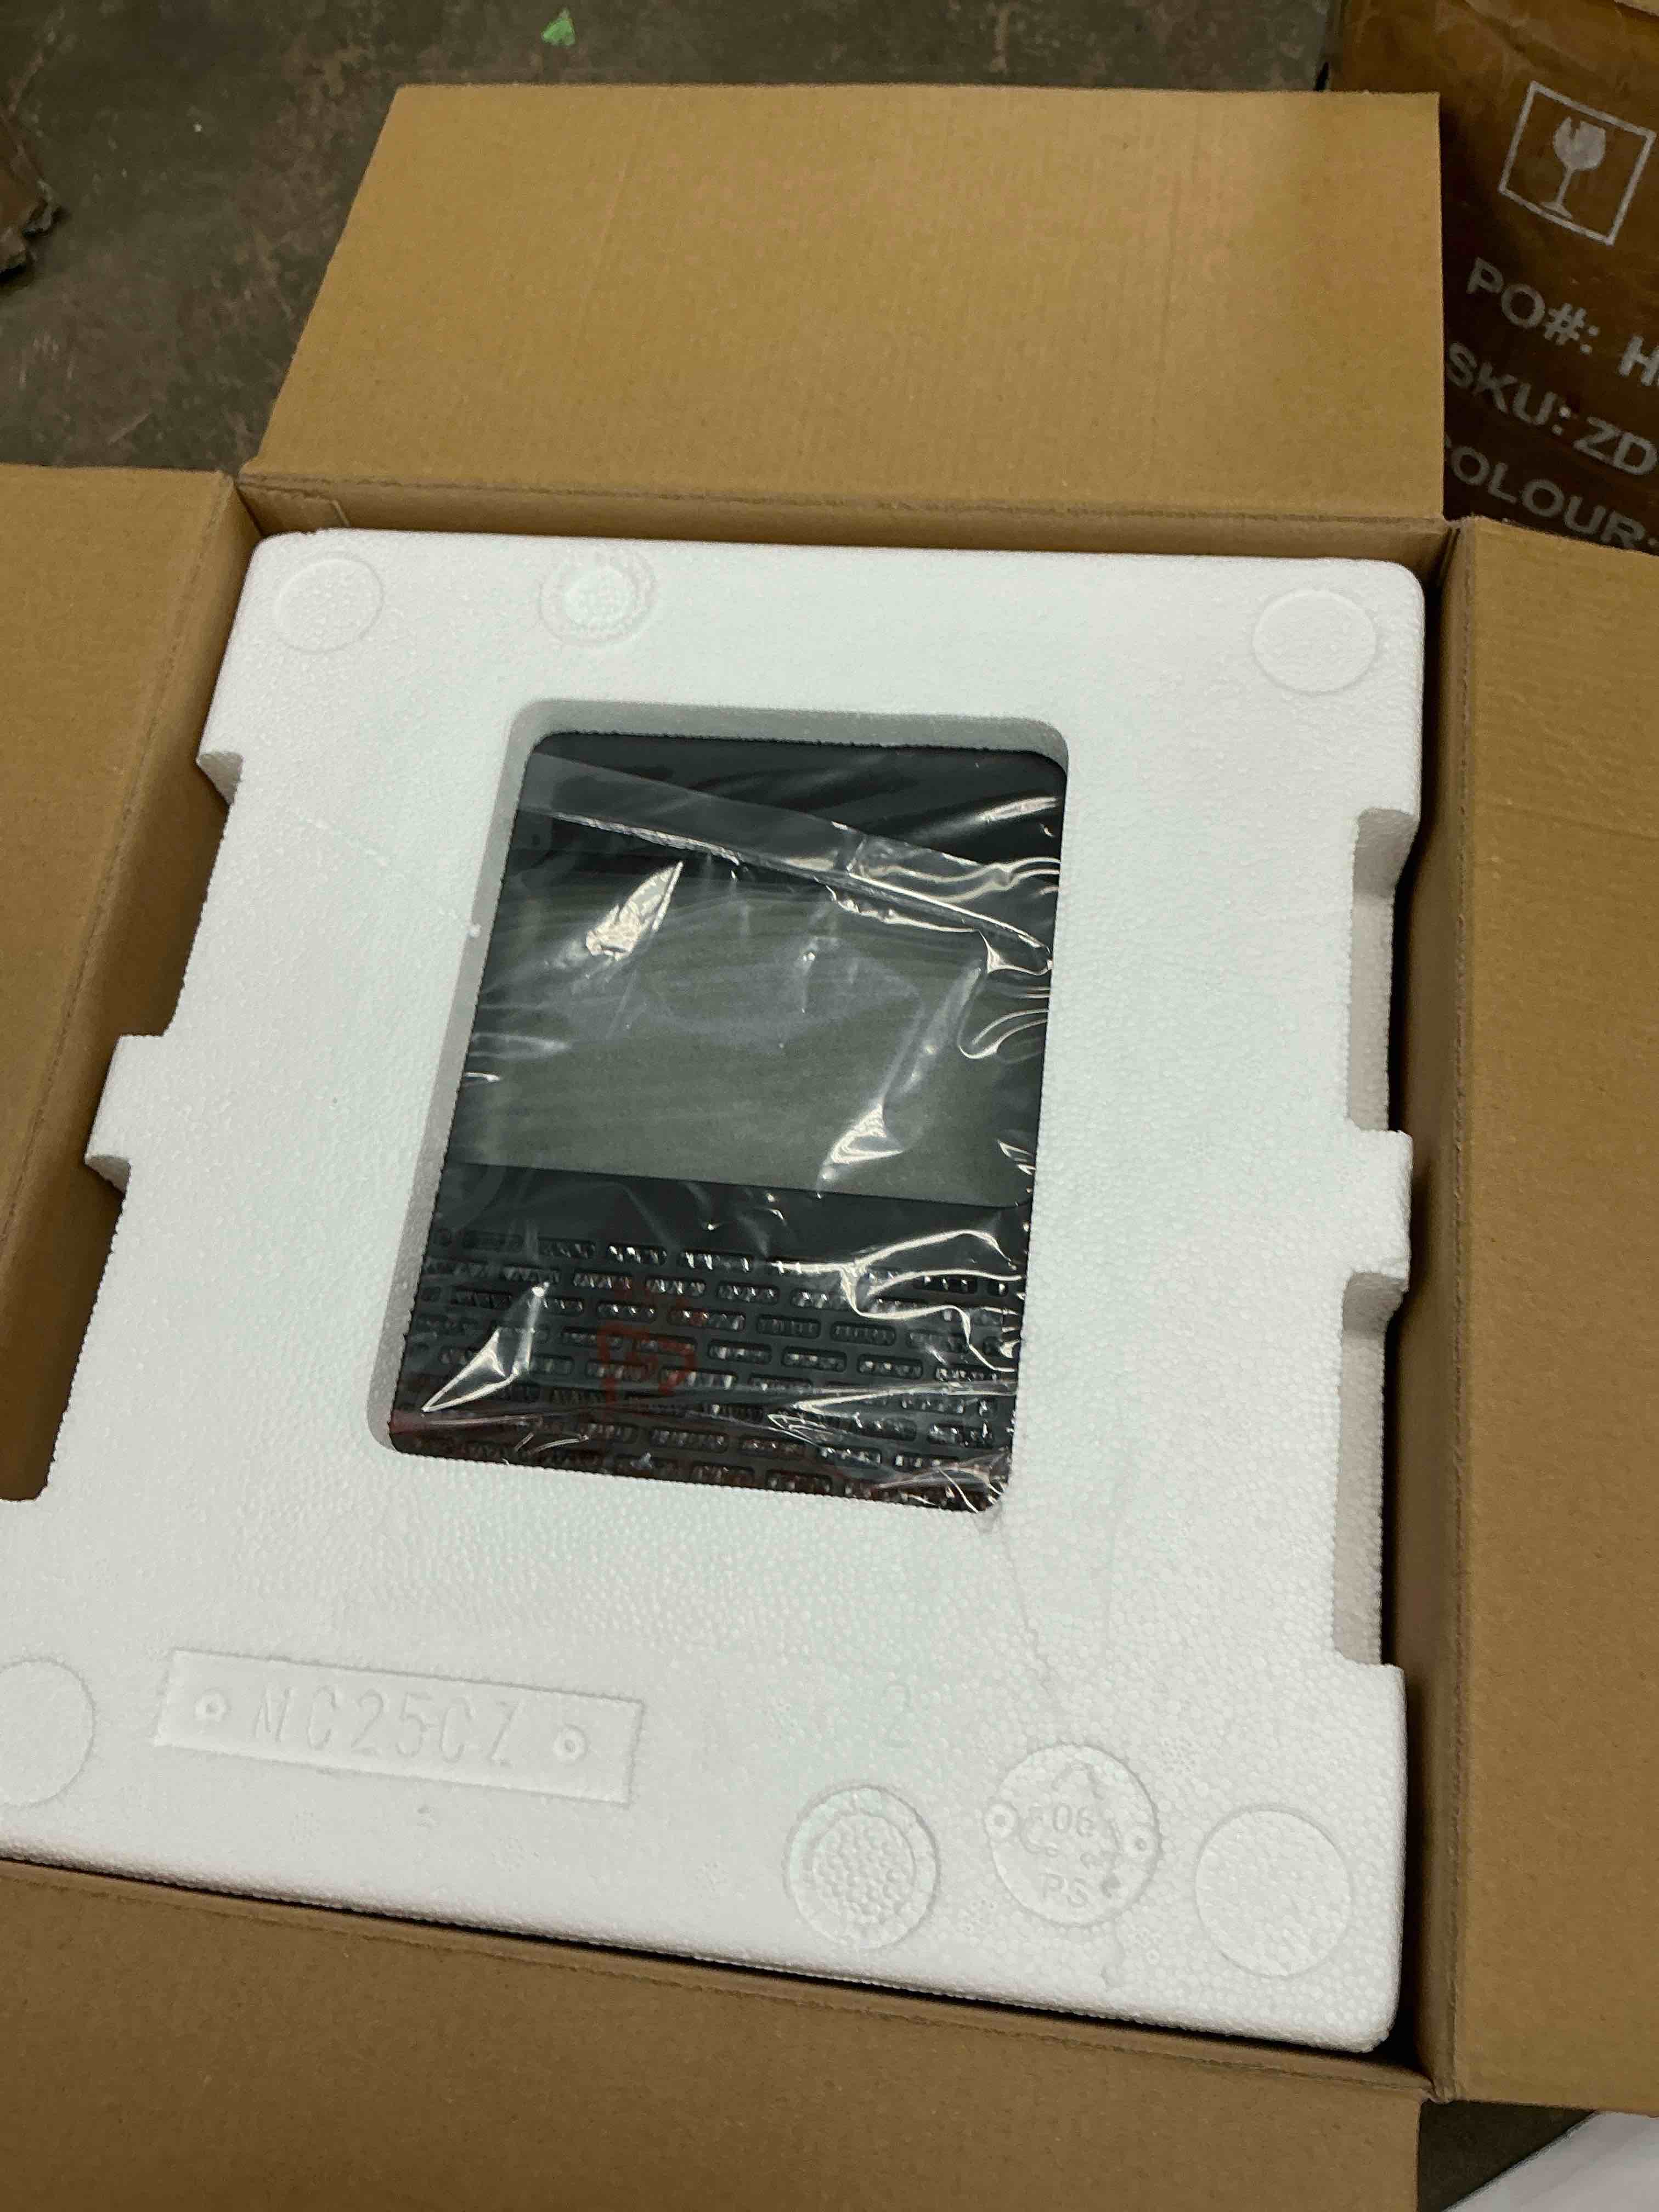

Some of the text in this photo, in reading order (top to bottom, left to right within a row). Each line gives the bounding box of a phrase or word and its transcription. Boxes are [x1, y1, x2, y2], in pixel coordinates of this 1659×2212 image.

[1466, 257, 1600, 356] PO#:
[1446, 341, 1658, 476] SKU: ZD
[253, 1682, 527, 1768] NC25CZ
